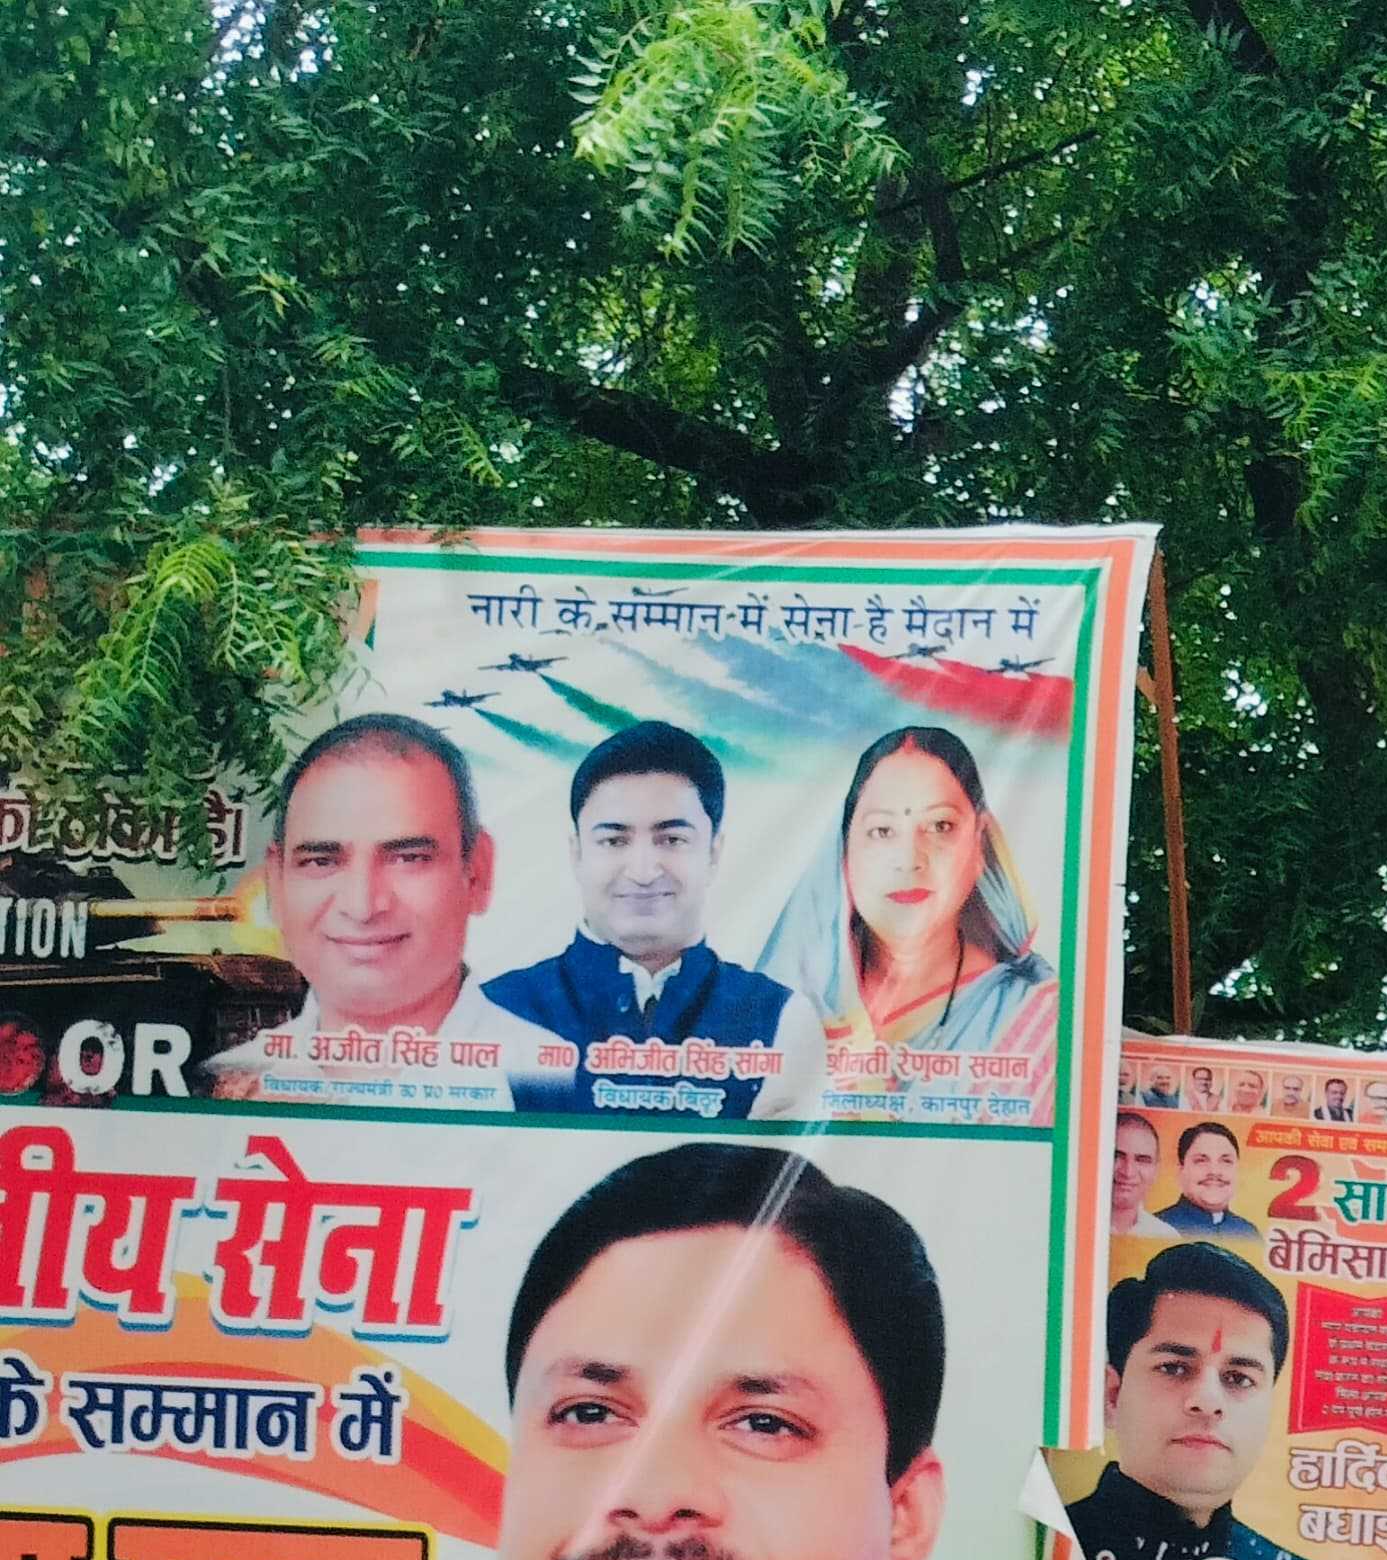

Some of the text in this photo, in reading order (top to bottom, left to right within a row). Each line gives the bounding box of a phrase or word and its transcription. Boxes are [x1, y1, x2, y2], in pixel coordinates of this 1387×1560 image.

[466, 585, 1040, 646] नारी के सम्मान में सेना है मैदान में
[308, 1030, 383, 1063] अजीत
[391, 1030, 441, 1066] सिंह
[449, 1042, 502, 1068] पाल
[590, 1038, 678, 1072] अभिजीत
[685, 1038, 728, 1076] सिंह
[896, 1048, 961, 1081] रेणुका
[968, 1056, 1030, 1080] सचान
[1267, 1155, 1323, 1222] 2
[212, 1135, 472, 1327] सेना
[67, 1379, 315, 1452] सम्मान
[340, 1370, 400, 1457] में
